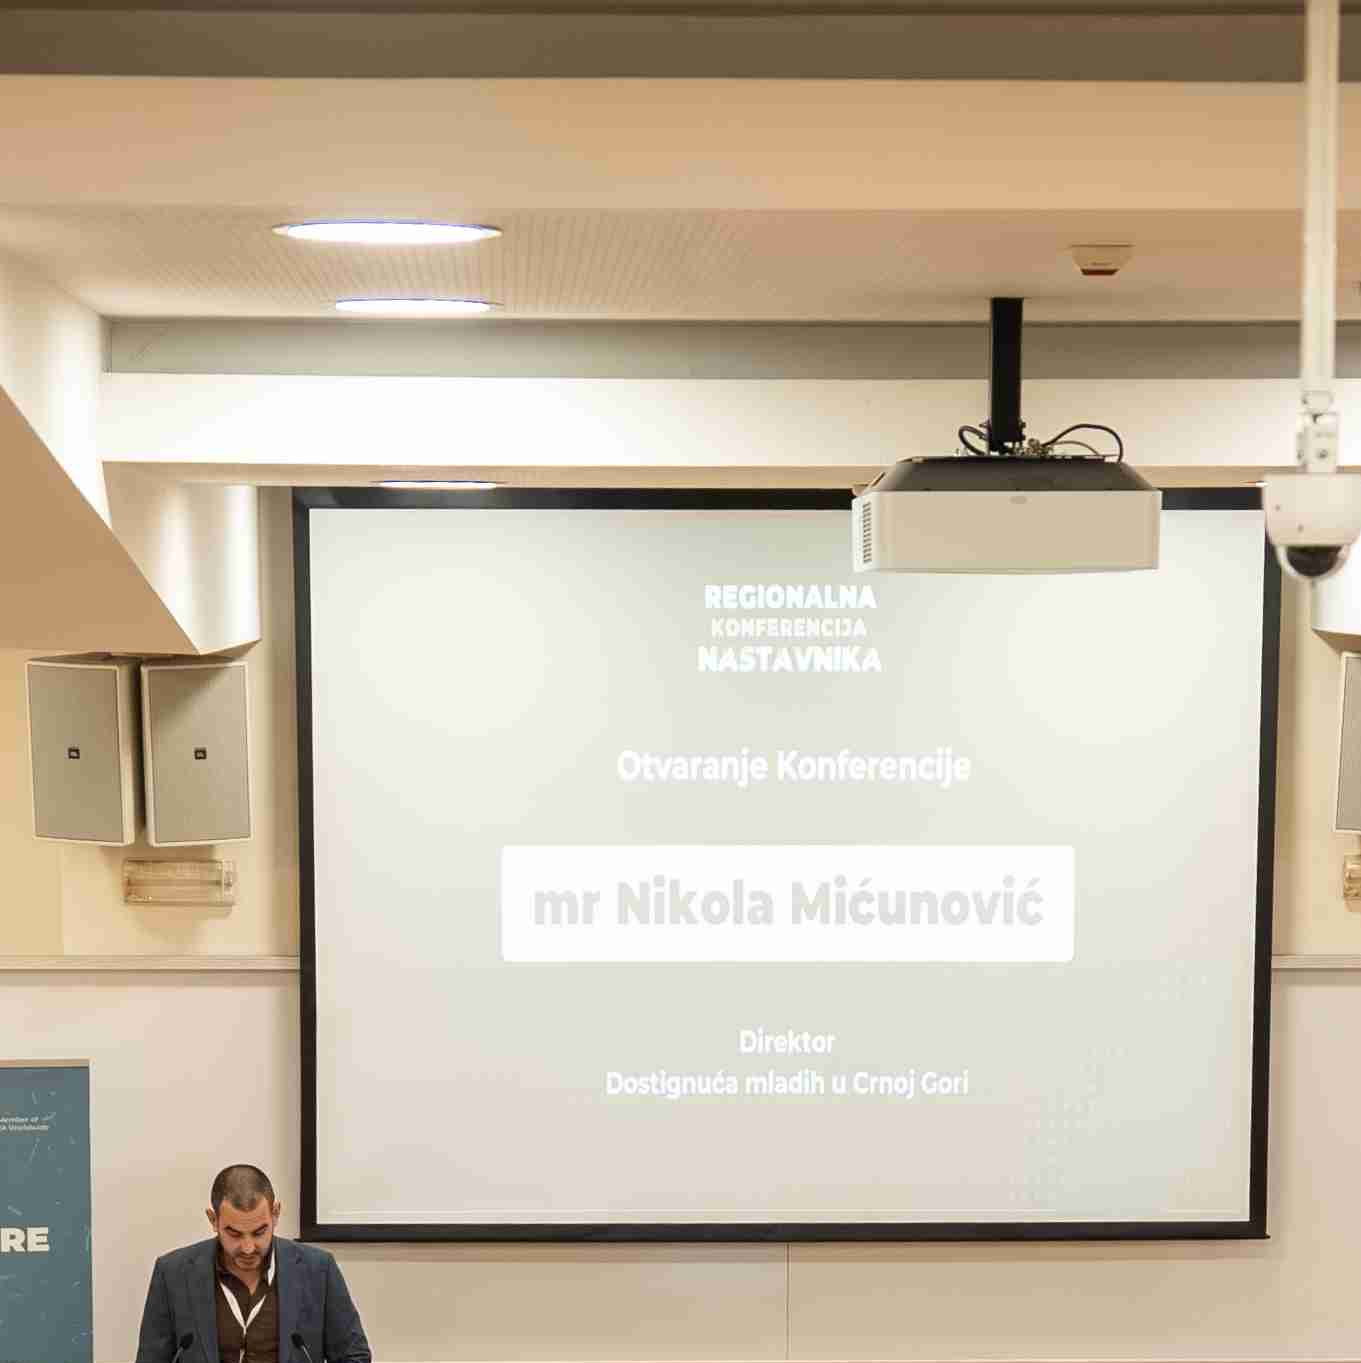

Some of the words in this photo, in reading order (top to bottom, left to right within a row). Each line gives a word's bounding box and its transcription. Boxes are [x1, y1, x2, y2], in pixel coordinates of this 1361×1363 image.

[704, 584, 879, 609] REGIONALNA
[711, 617, 868, 638] KONFERENCIJA
[697, 645, 882, 672] NASTAVNIKA
[616, 749, 770, 788] Otvaranje
[776, 749, 972, 788] Konferencije
[532, 888, 601, 926] mr
[616, 874, 774, 926] Nikola
[791, 873, 1045, 926] Mićunović
[738, 1027, 836, 1053] Direktor
[605, 1069, 739, 1099] Dostignuća
[744, 1068, 825, 1095] mladih
[831, 1074, 847, 1095] u
[853, 1070, 916, 1099] Crnoj
[921, 1069, 970, 1095] Gori
